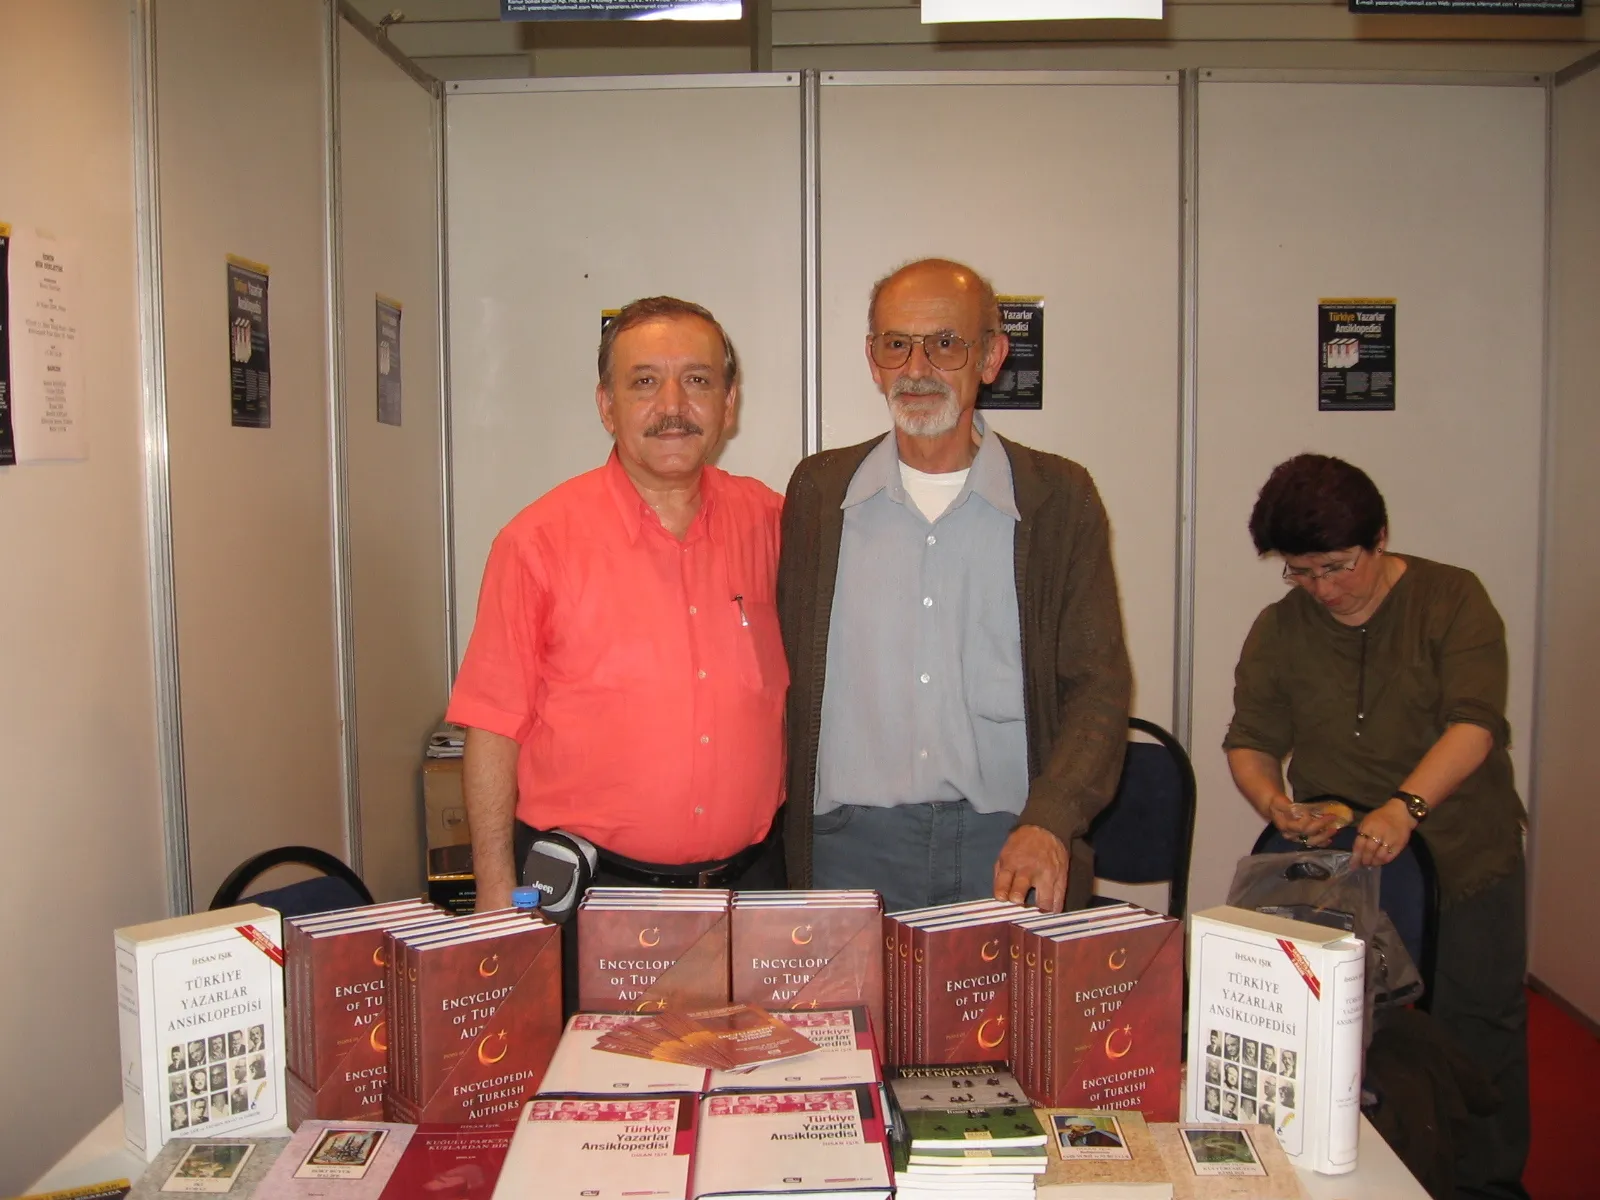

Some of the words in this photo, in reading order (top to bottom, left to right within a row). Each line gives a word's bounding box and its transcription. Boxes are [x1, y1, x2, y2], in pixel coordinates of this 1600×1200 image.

[1003, 309, 1033, 320] Yazarlar
[1329, 311, 1356, 323] Türkiye
[1356, 311, 1386, 322] Yazarlar
[1335, 323, 1382, 335] Ansiklopedisi
[1235, 951, 1257, 964] İHSAN
[1258, 957, 1272, 968] IŞIK
[185, 969, 242, 992] TÜRKİYE
[631, 974, 657, 985] TUR
[785, 974, 814, 984] TUR
[946, 972, 1007, 992] ENCYCLOP
[1227, 971, 1280, 995] TÜRKİYE
[335, 979, 385, 998] ENCYCL
[772, 990, 798, 1000] AUT
[181, 986, 248, 1010] YAZARLAR
[346, 1001, 360, 1012] OF
[365, 996, 383, 1009] TU
[955, 997, 968, 1007] OF
[973, 990, 996, 1003] TUR
[1222, 987, 1283, 1014] YAZARLAR
[168, 1000, 263, 1032] ANSİKLOPEDİSİ
[453, 1014, 466, 1025] OF
[470, 1006, 496, 1021] TUR
[1084, 1007, 1096, 1017] OF
[1100, 1000, 1122, 1014] TUR
[1208, 1003, 1297, 1037] ANSİKLOPEDİSİ
[345, 1065, 388, 1082] ENCYCL
[1082, 1066, 1155, 1090] ENCYCLOPEDIA
[354, 1082, 366, 1093] OF
[453, 1070, 534, 1097] ENCYCLOPEDIA
[1090, 1092, 1100, 1102] OF
[1103, 1081, 1146, 1098] TURKISH
[361, 1093, 383, 1106] AUT
[462, 1099, 474, 1108] OF
[477, 1086, 524, 1104] TURKISH
[1095, 1096, 1141, 1111] AUTHORS
[468, 1100, 519, 1120] AUTHORS
[808, 1113, 855, 1124] Türkiye
[624, 1125, 671, 1135] Türkiye
[802, 1122, 856, 1131] Yazarlar
[616, 1133, 670, 1142] Yazarlar
[770, 1130, 858, 1141] Ansiklopedisi
[581, 1141, 669, 1152] Ansiklopedisi
